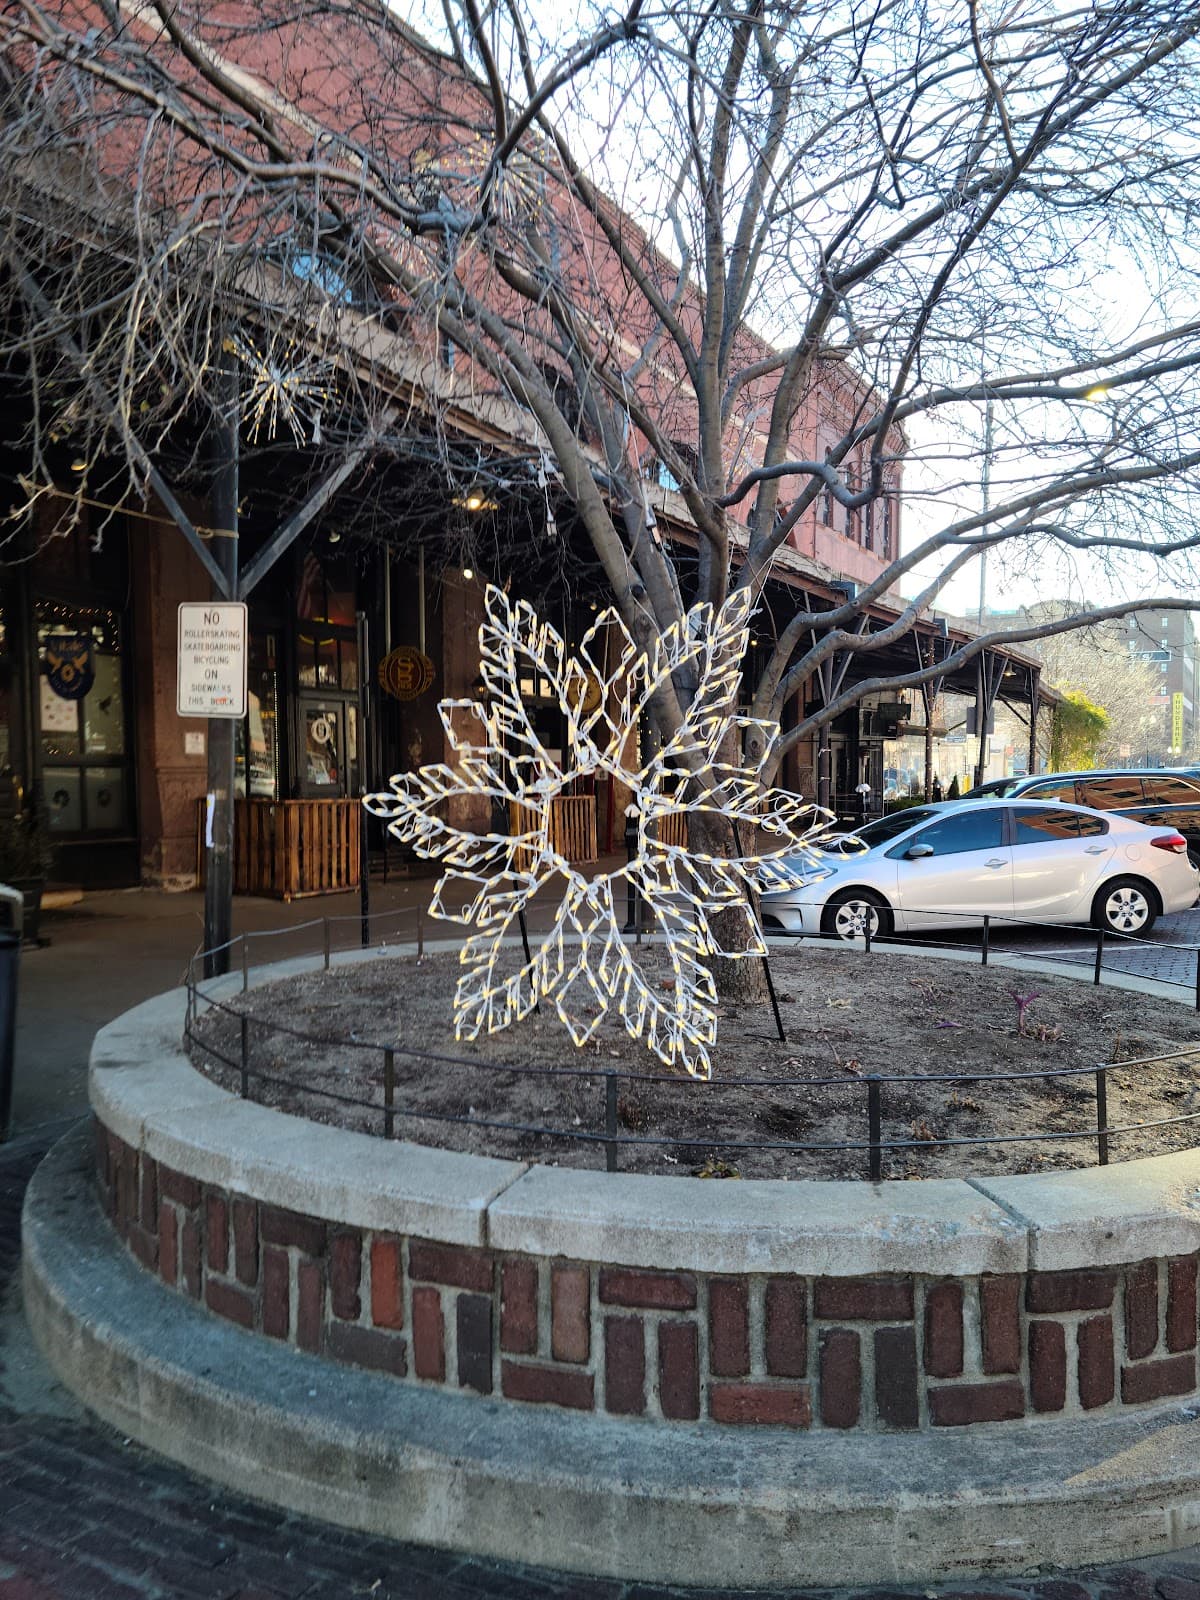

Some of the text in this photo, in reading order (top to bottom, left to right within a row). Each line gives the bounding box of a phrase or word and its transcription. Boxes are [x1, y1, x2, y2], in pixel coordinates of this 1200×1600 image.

[203, 612, 220, 625] NO
[184, 629, 240, 639] ROLLERSKATING
[184, 642, 241, 652] SKATEBOARDING
[193, 655, 229, 665] BICYCLING
[204, 668, 218, 680] ON
[188, 696, 204, 706] THIS
